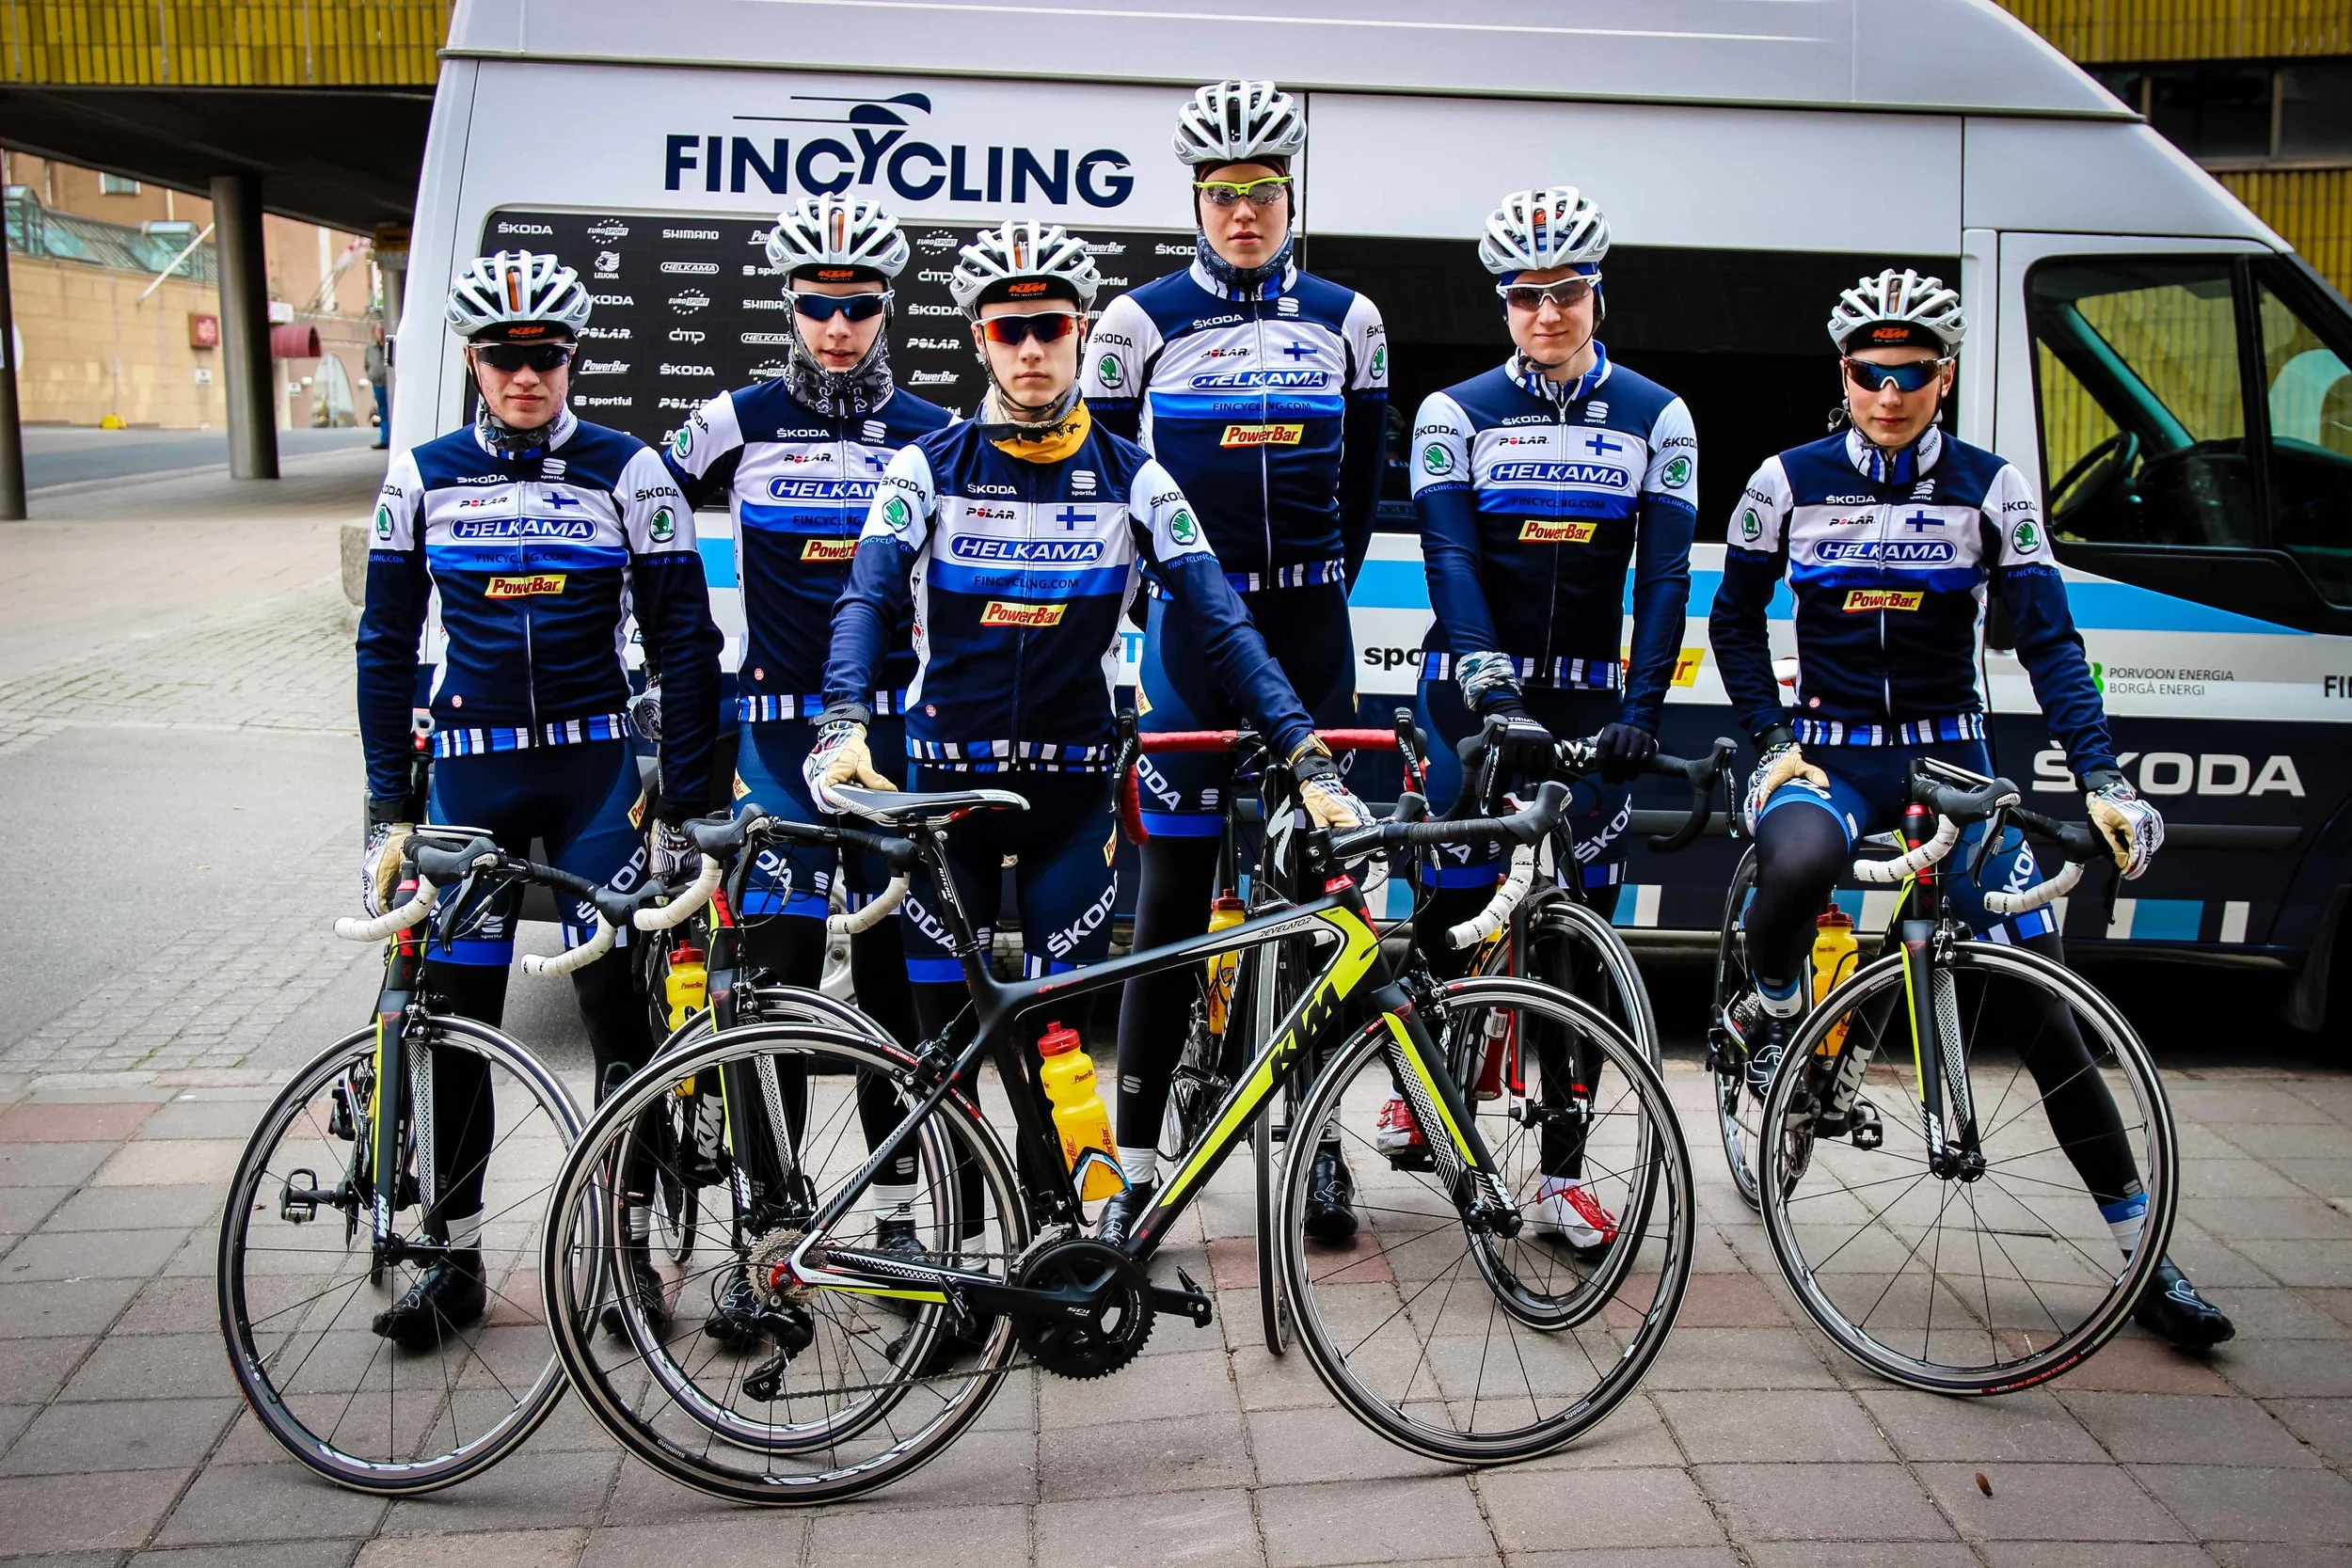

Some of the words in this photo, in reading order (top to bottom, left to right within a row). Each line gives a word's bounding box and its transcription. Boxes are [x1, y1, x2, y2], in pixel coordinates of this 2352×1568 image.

[664, 128, 1135, 209] FINCYCLING
[498, 222, 553, 235] ŠKODA
[662, 229, 720, 240] SHIMANO
[1155, 243, 1197, 255] ŠKOD
[1009, 282, 1047, 293] KTM
[1098, 277, 1127, 286] ortful
[591, 294, 634, 306] KODA
[743, 299, 784, 310] SHIMA
[909, 303, 962, 316] ŠKODA
[1192, 314, 1244, 329] ŠKODA
[745, 334, 792, 342] HELKAM
[1367, 324, 1385, 339] ŠKO
[1872, 327, 1910, 338] KTM
[1093, 333, 1134, 349] ŠKODA
[582, 359, 629, 372] PowerBar
[660, 363, 715, 376] ŠKODA
[749, 368, 787, 377] EUROSPOR
[912, 370, 959, 383] PowerBar
[589, 396, 632, 406] sportful
[1212, 402, 1312, 412] FINCYCLNG.COM
[691, 410, 708, 435] ODA
[1501, 414, 1552, 426] ŠKODA
[777, 428, 831, 438] ŠKODA
[1227, 425, 1297, 443] PowerBar
[1414, 424, 1460, 440] ŠKODA
[1499, 436, 1548, 446] POLAR
[1662, 436, 1697, 449] ŠKOD
[784, 453, 829, 463] POLAR
[456, 474, 509, 484] ŠKODA
[1496, 464, 1624, 485] HELKAMA
[635, 486, 680, 503] ŠKODA
[776, 482, 878, 498] HELKA
[882, 476, 926, 502] ŠKODA
[967, 483, 1018, 495] ŠKODA
[459, 497, 508, 508] POLAR
[1150, 491, 1187, 509] ŠKOD
[1512, 497, 1605, 511] FINCYCLNG.COM
[1745, 488, 1774, 507] KODA
[1826, 494, 1877, 505] ŠKODA
[965, 506, 1013, 519] POLAR
[2001, 500, 2038, 513] KOD
[459, 519, 589, 538] HELKAMA
[1829, 516, 1872, 526] POLAR
[1525, 522, 1590, 540] PowerBar
[808, 542, 858, 559] Power
[958, 539, 1100, 560] HELKAMA
[1823, 541, 1947, 561] HELKAMA
[476, 551, 572, 564] FINCYCNG.COM
[492, 578, 560, 594] PowerBar
[974, 576, 1079, 590] FINCYCLING.COM
[1849, 593, 1915, 608] PowerBar
[988, 605, 1059, 625] PowerBar
[2109, 667, 2175, 680] PORVOON
[2179, 669, 2234, 681] ENERGIA
[2109, 681, 2156, 694] BORGÅ
[2159, 683, 2205, 695] ENERGI
[1398, 736, 1419, 771] SRAM
[2032, 740, 2306, 797] ŠODA
[1136, 753, 1183, 812] ODA
[1574, 793, 1632, 863] ŠKOD
[938, 867, 955, 905] RITCHEY
[905, 893, 957, 950] ODA
[1047, 870, 1118, 958] ŠKOD
[1258, 917, 1312, 938] REVELATOR
[1869, 975, 1895, 990] SHIMANO
[1834, 1044, 1873, 1112] KTM
[694, 1092, 723, 1160] KTM
[1929, 1111, 1944, 1154] KTM
[1565, 1401, 1591, 1420] SHIMANO
[657, 1438, 687, 1460] SHIMANO
